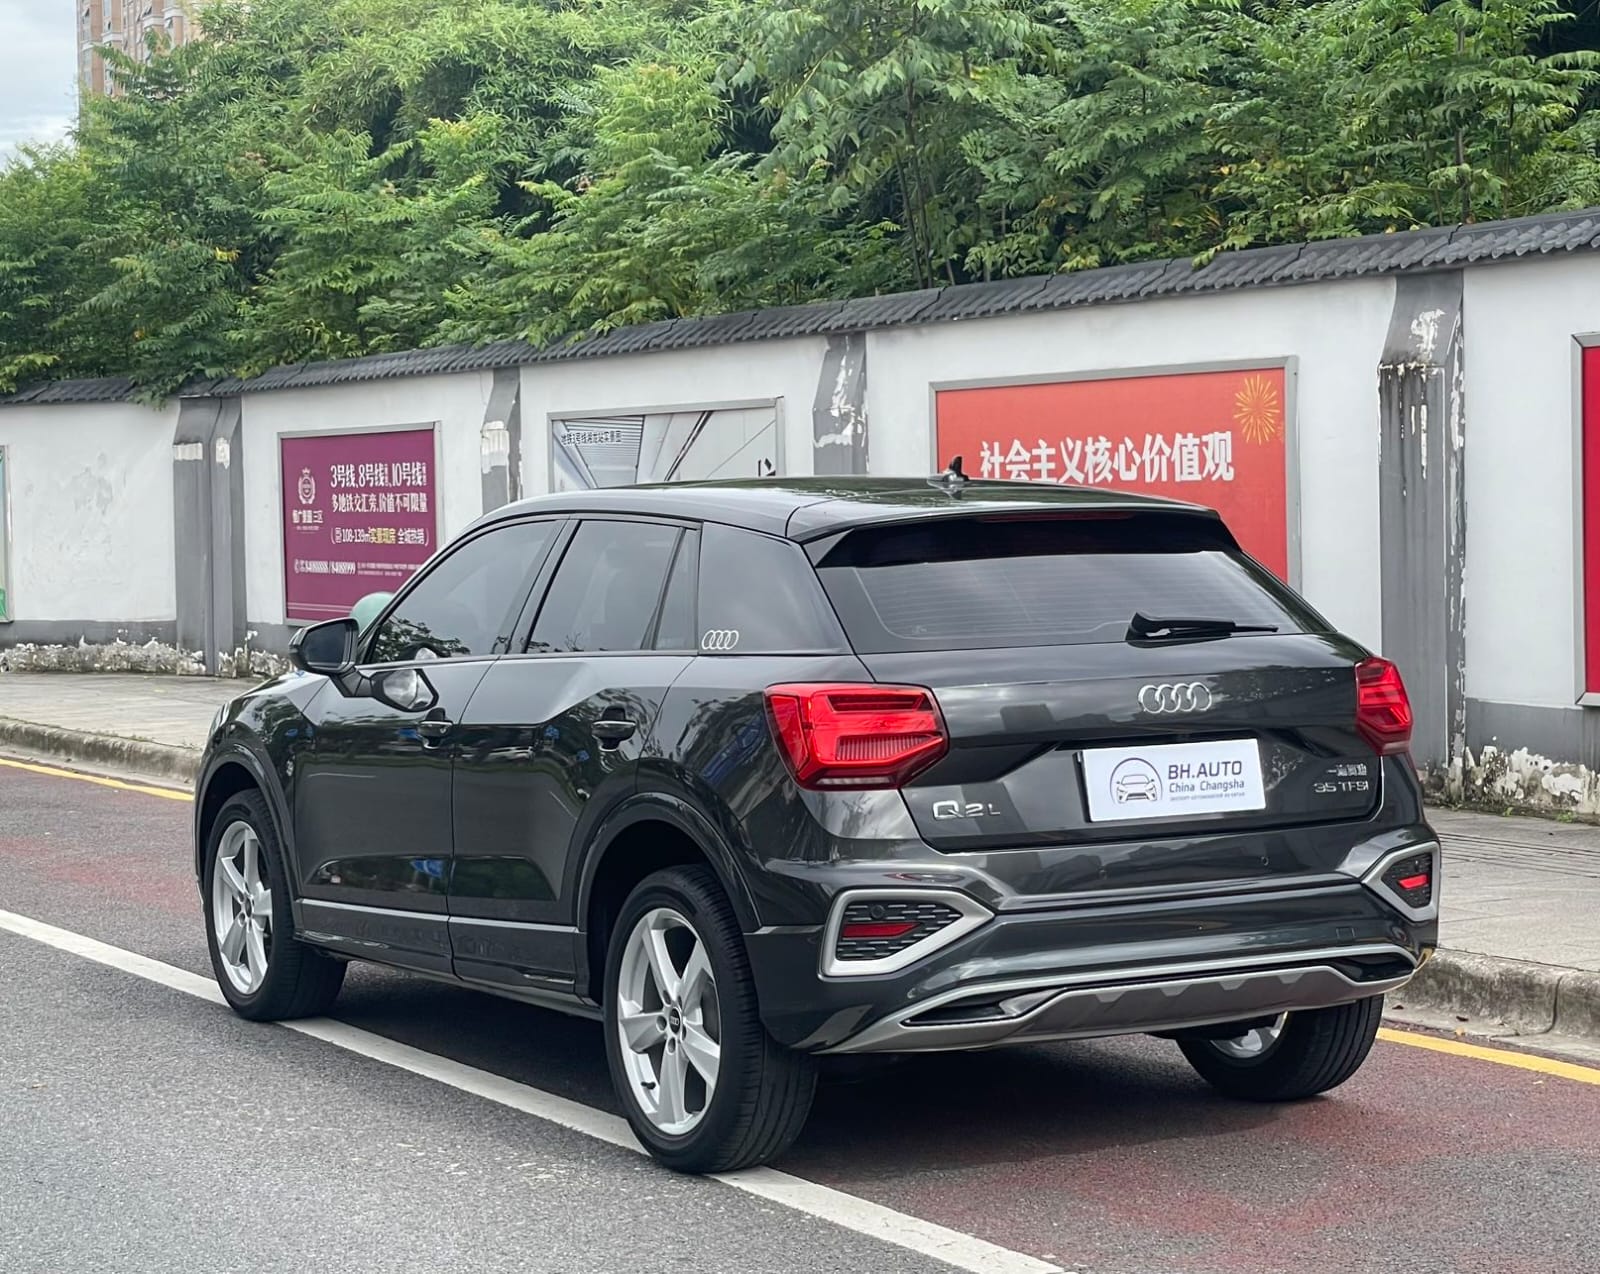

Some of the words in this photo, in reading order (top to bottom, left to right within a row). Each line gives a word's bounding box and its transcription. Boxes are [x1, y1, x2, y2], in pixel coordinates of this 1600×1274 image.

[980, 430, 1234, 483] 社会主义核心价值观
[1168, 760, 1242, 780] BH.AUTO
[1169, 781, 1195, 793] China
[1199, 778, 1245, 792] Changsha
[1313, 782, 1337, 793] 35
[1338, 780, 1369, 792] TFSI
[932, 800, 1001, 820] Q2L
